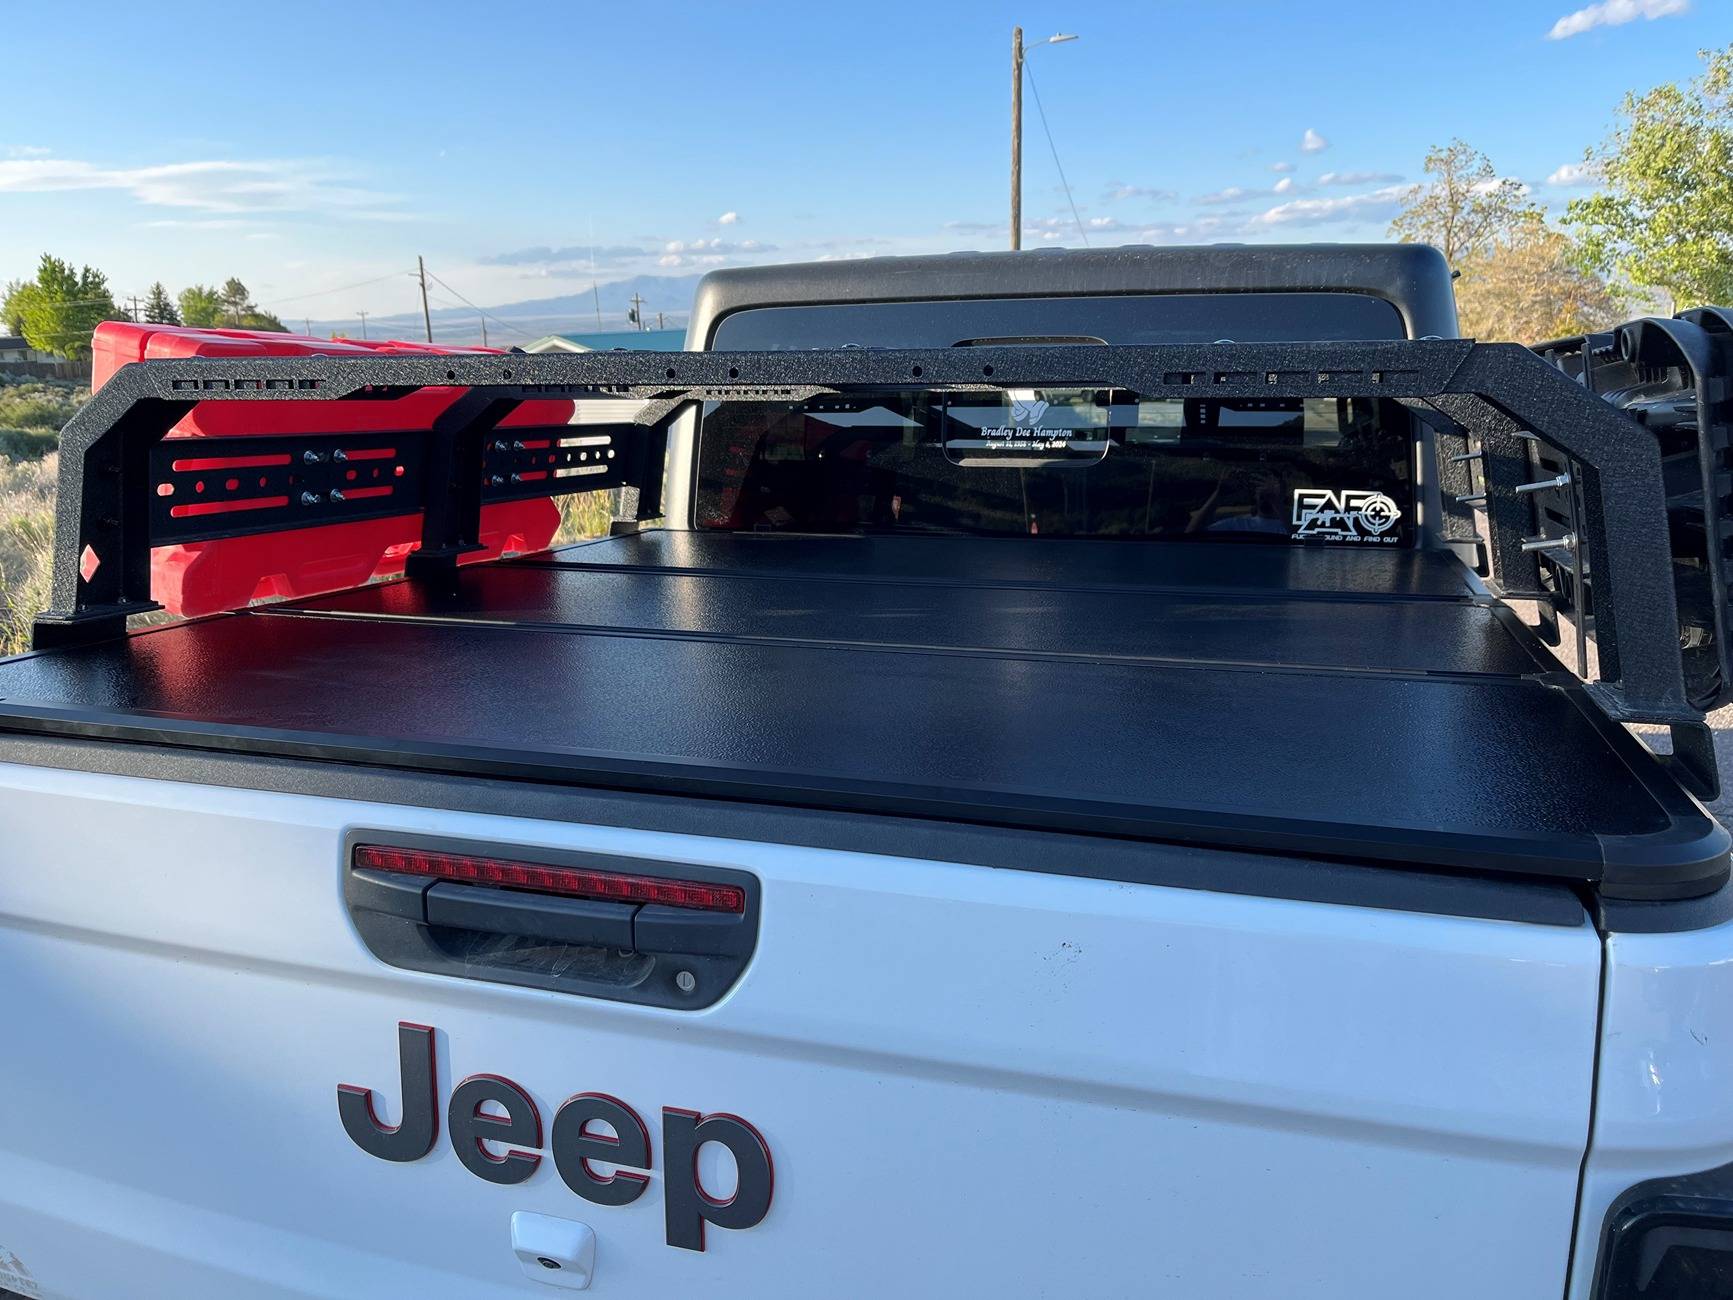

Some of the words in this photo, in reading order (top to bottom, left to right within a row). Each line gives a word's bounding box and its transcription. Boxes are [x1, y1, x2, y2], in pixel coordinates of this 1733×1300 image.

[981, 425, 1013, 440] Bradley
[1016, 426, 1031, 437] Dee
[1033, 425, 1072, 440] Hampton
[336, 1021, 775, 1253] Jeep
